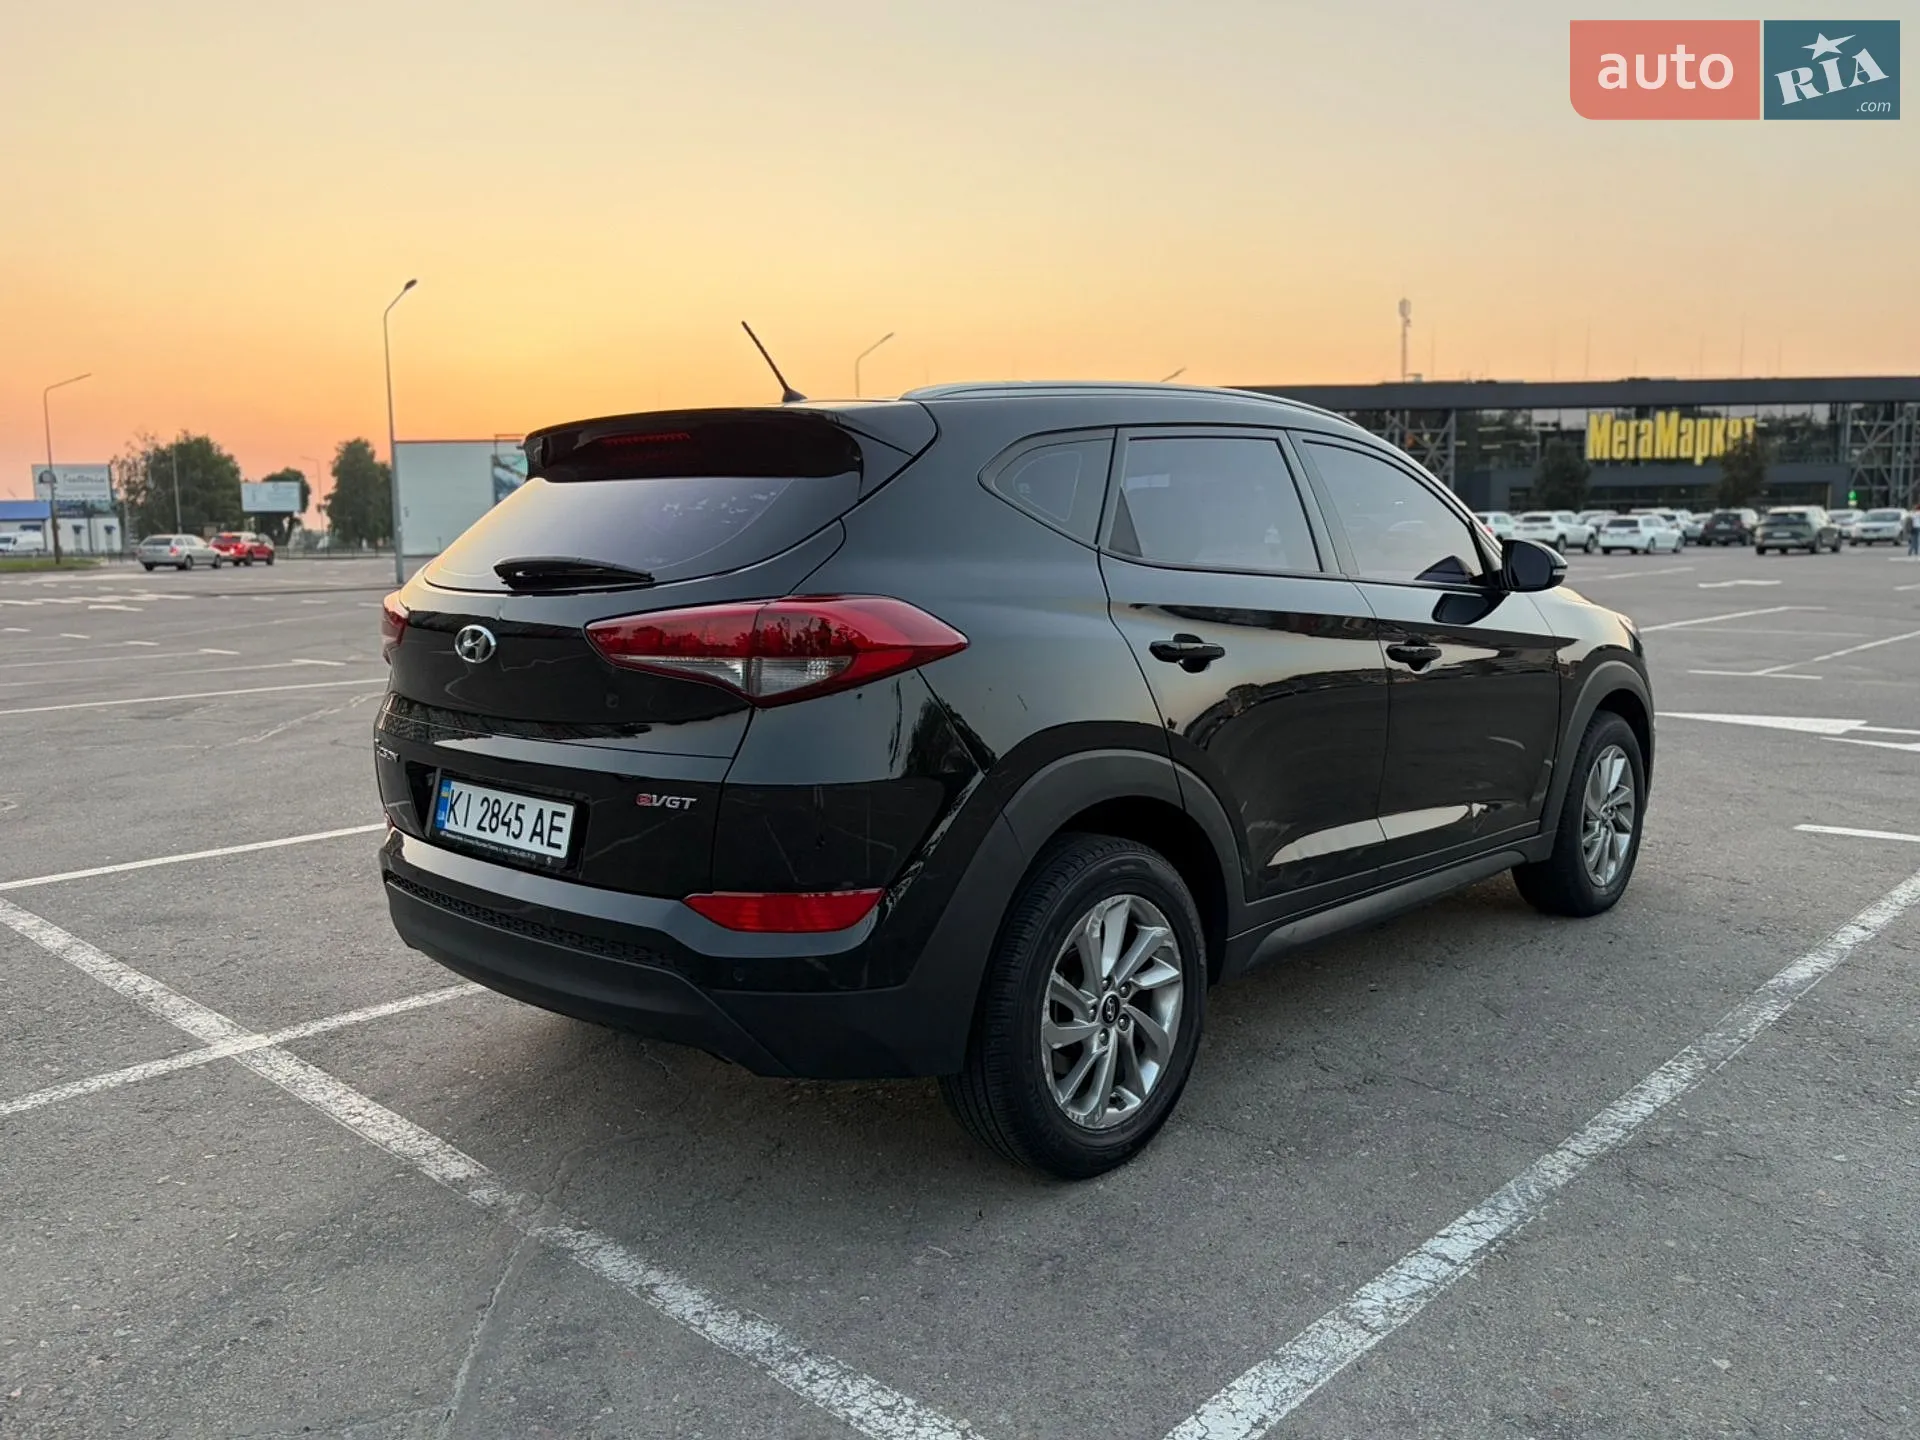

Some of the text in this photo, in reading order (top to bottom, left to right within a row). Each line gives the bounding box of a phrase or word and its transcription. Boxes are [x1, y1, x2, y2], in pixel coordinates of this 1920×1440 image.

[447, 789, 472, 827] KI
[476, 796, 527, 840] 2845
[528, 808, 566, 849] AE
